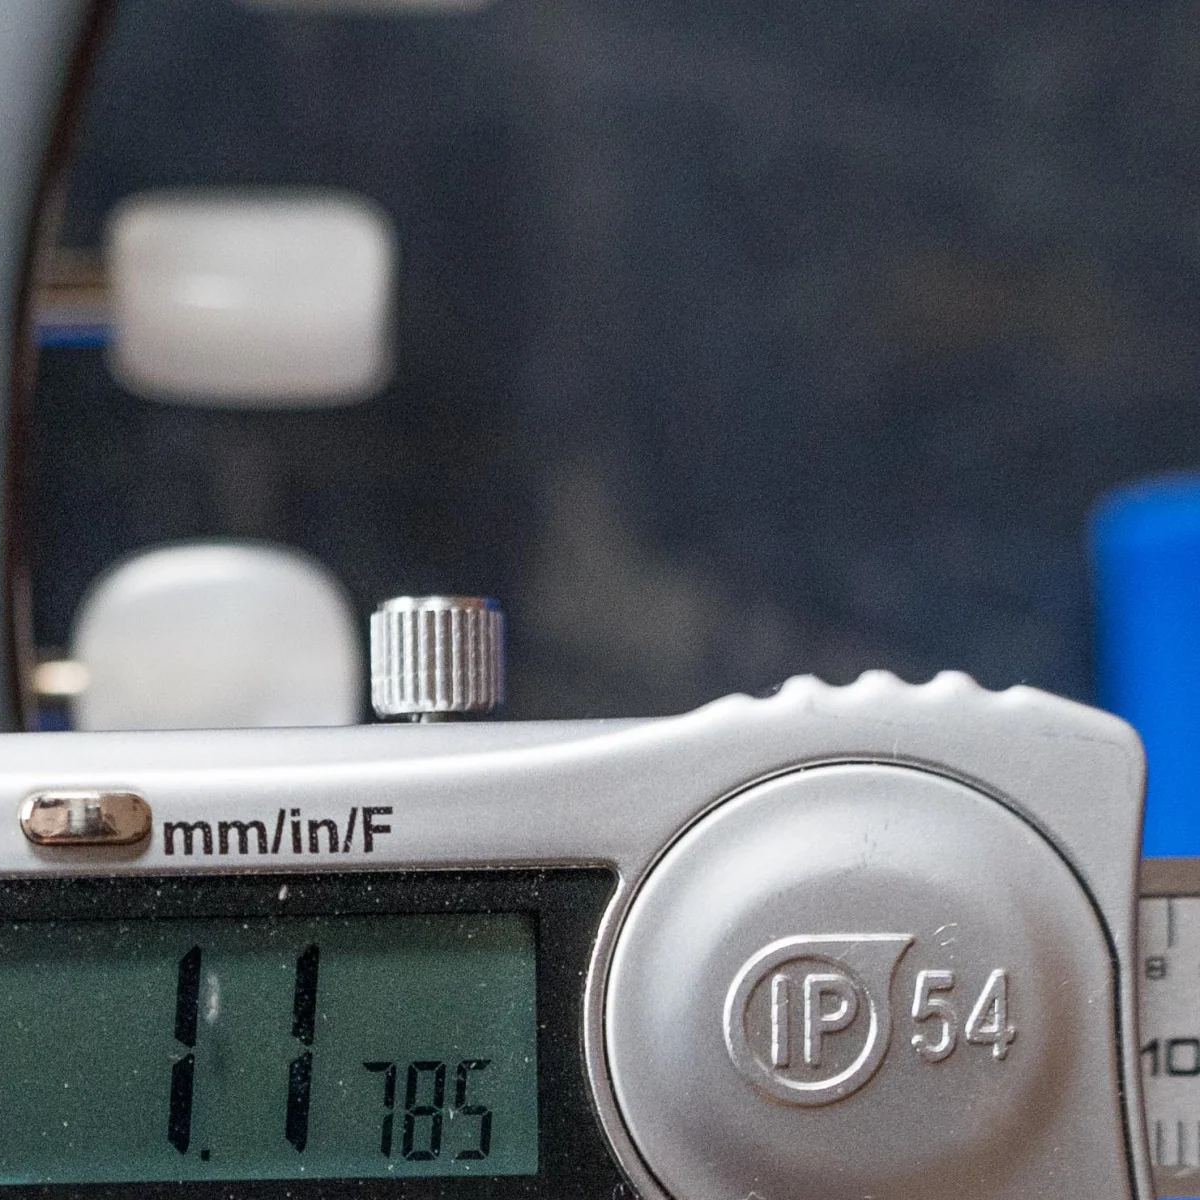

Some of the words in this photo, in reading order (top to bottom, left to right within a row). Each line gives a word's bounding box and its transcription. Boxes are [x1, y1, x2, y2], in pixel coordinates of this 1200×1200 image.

[162, 806, 394, 856] mm/in/F
[1145, 956, 1166, 980] 8
[771, 973, 860, 1069] IP
[911, 968, 1016, 1064] 54
